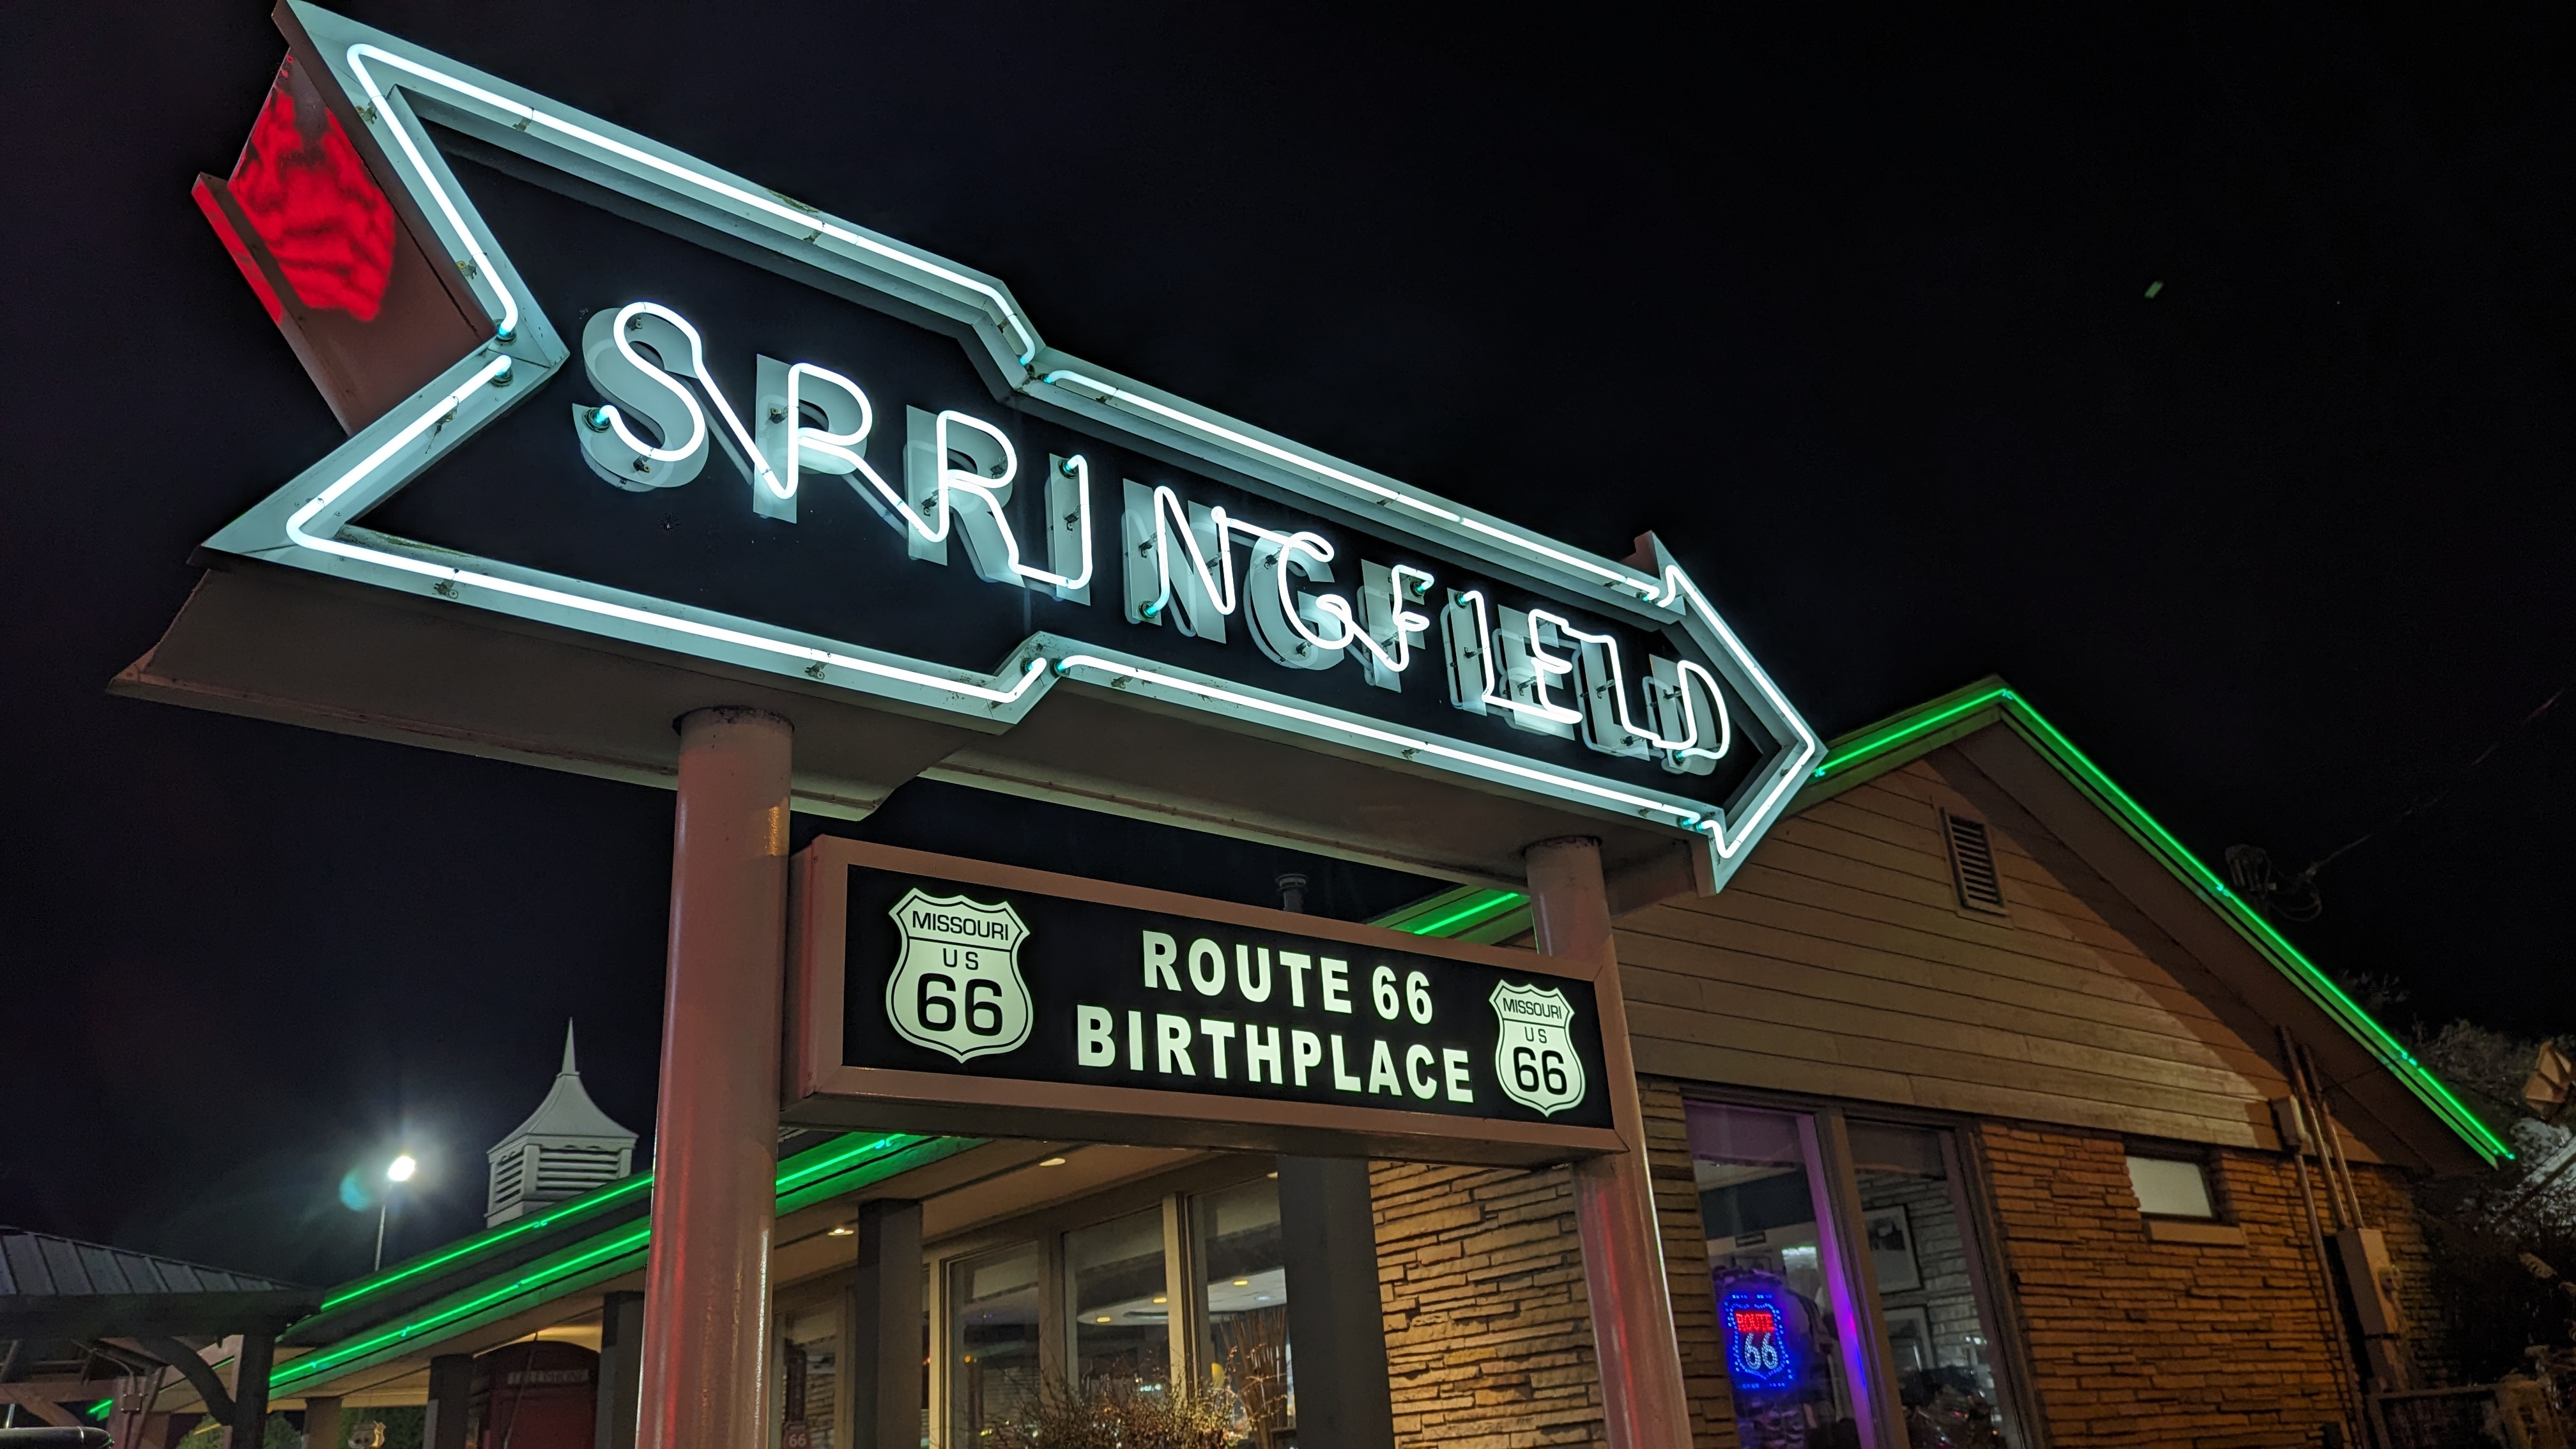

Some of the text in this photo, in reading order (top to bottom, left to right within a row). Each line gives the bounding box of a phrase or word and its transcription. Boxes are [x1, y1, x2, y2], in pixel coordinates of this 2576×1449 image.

[572, 302, 1730, 775] SPRINGFIELD
[912, 910, 1008, 940] MISSOURI
[1142, 930, 1433, 1025] ROUTE 66
[917, 972, 1002, 1036] 66
[1503, 997, 1562, 1020] MISSOURI
[1076, 1004, 1474, 1103] BIRTHPLACE
[1514, 1046, 1567, 1095] 66
[1736, 1313, 1776, 1331] ROUTE
[1745, 1332, 1779, 1370] 66
[788, 1434, 807, 1447] 66
